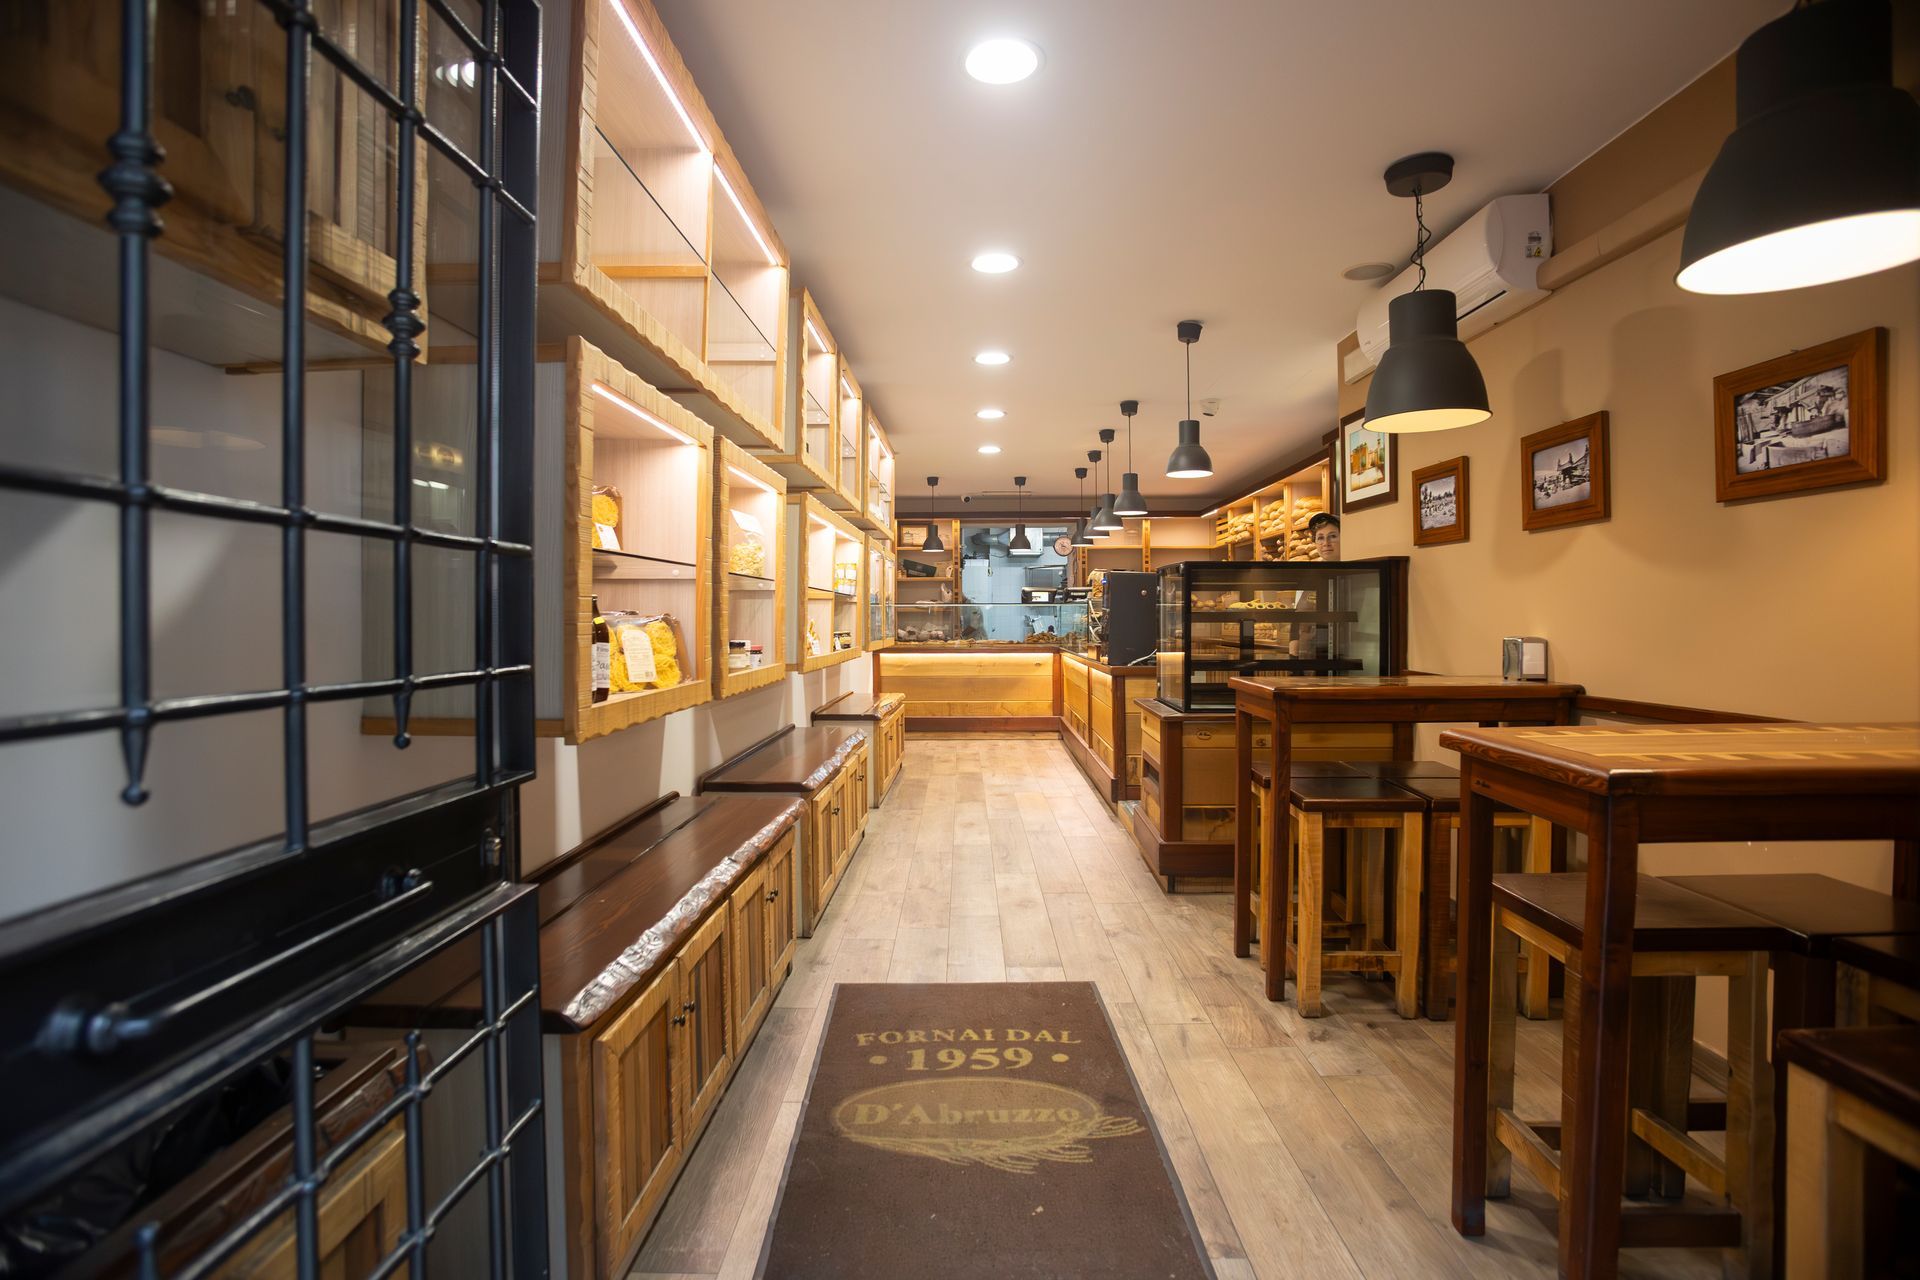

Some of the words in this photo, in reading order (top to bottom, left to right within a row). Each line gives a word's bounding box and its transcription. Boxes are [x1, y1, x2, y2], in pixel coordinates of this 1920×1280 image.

[856, 1028, 995, 1046] FORNAI
[1006, 1028, 1082, 1044] DAL
[905, 1047, 1033, 1071] 1959
[853, 1103, 1081, 1125] D'Abruzzo
